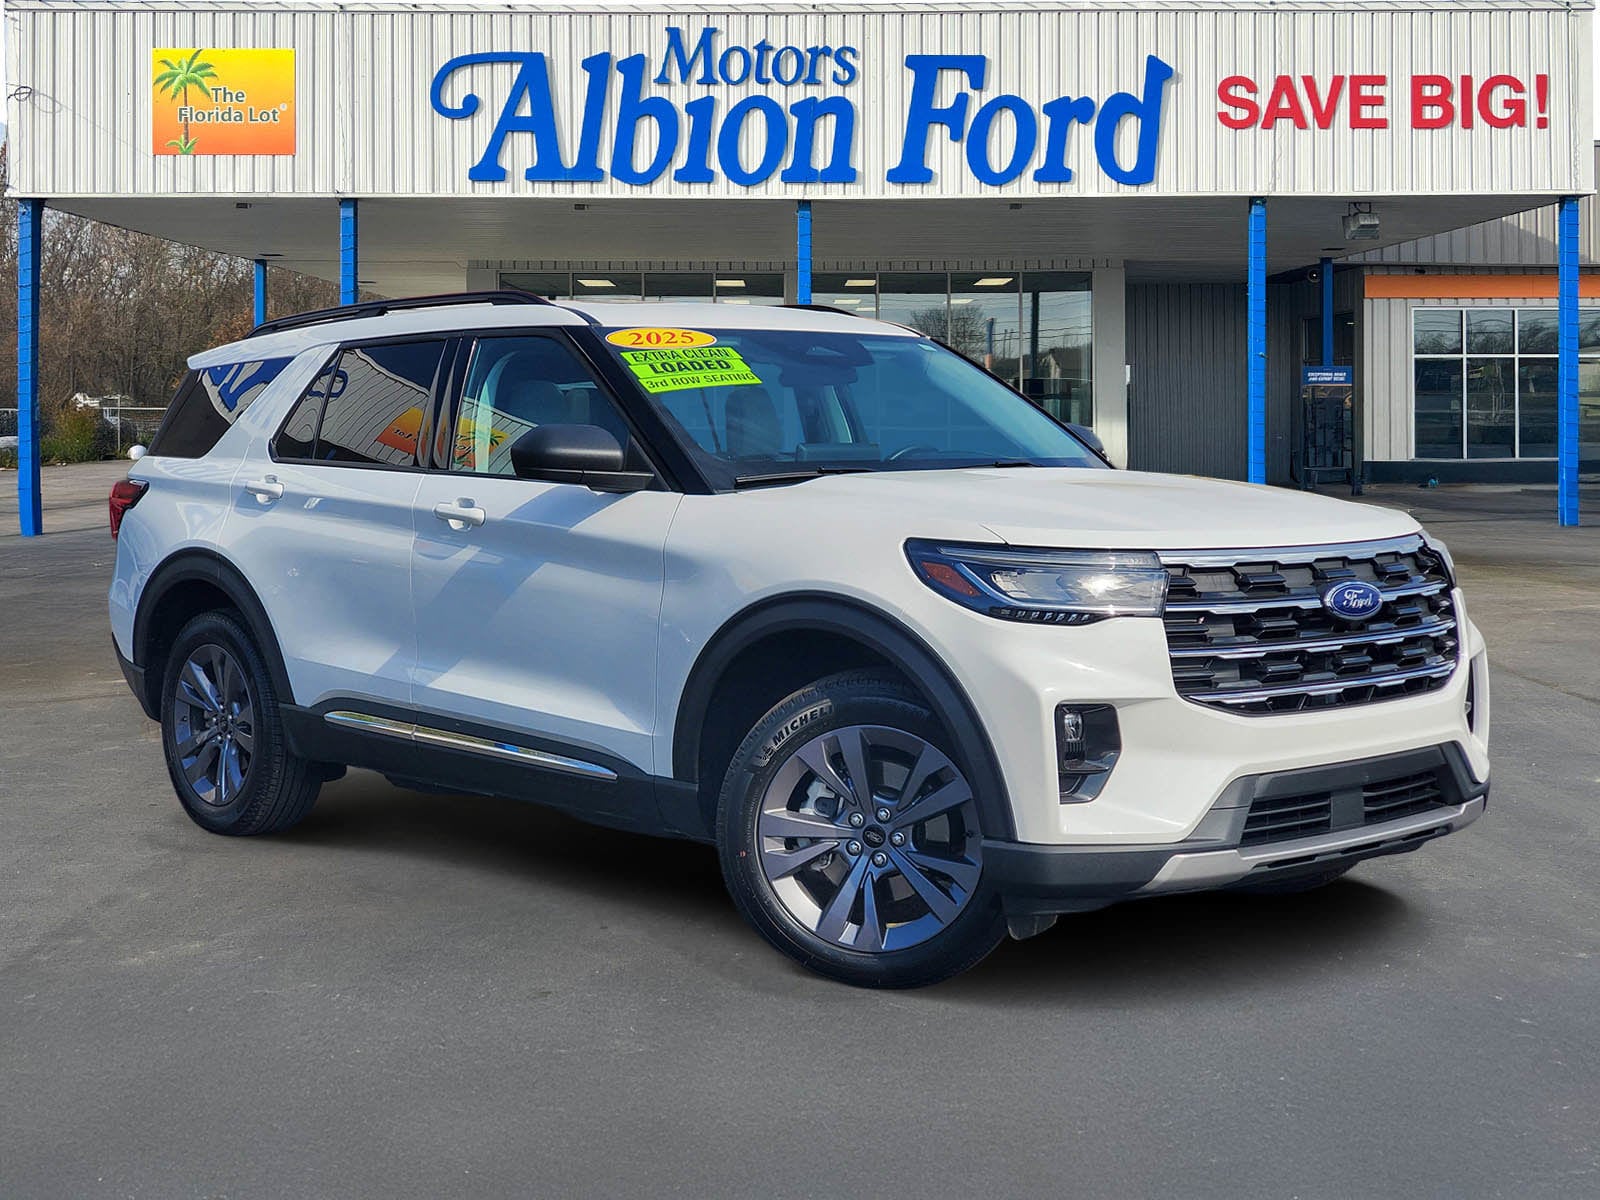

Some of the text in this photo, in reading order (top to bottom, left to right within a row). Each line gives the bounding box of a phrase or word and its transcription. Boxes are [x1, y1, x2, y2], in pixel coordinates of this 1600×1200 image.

[653, 26, 858, 86] Motors
[211, 87, 246, 103] The
[1217, 74, 1548, 130] SAVE BIG!
[178, 107, 279, 122] Florida Lot
[430, 51, 1174, 186] Albion Ford
[628, 331, 695, 345] 2025
[631, 348, 730, 363] EXTRA CLEAN
[649, 359, 732, 374] LOADED
[645, 372, 756, 389] 3rd ROW SEATING
[1343, 589, 1373, 609] Ford
[772, 704, 834, 746] MICHELI
